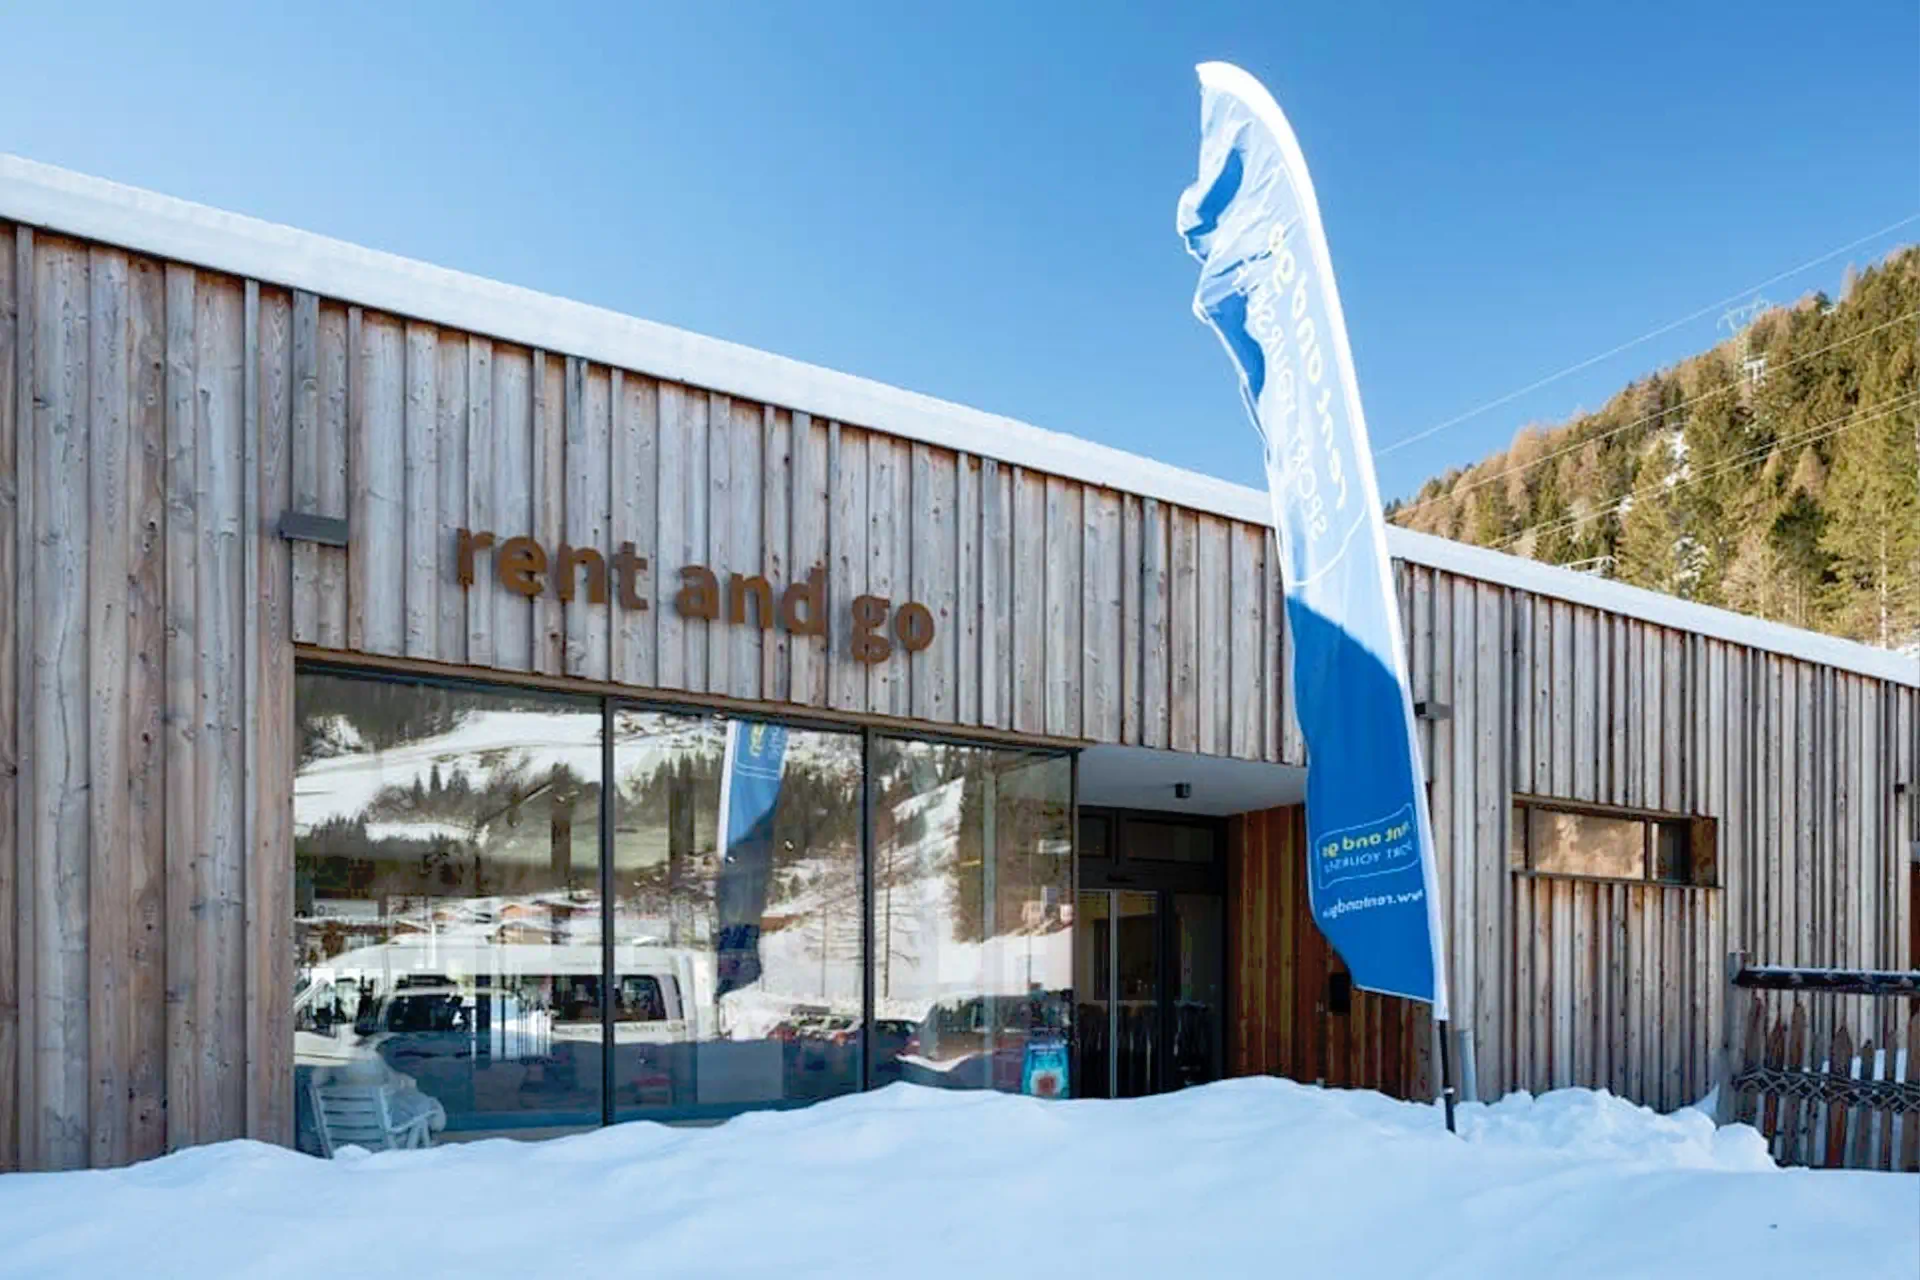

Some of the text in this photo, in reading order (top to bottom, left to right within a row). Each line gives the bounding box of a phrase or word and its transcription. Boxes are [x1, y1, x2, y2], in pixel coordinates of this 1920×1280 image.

[456, 526, 935, 664] rent and go
